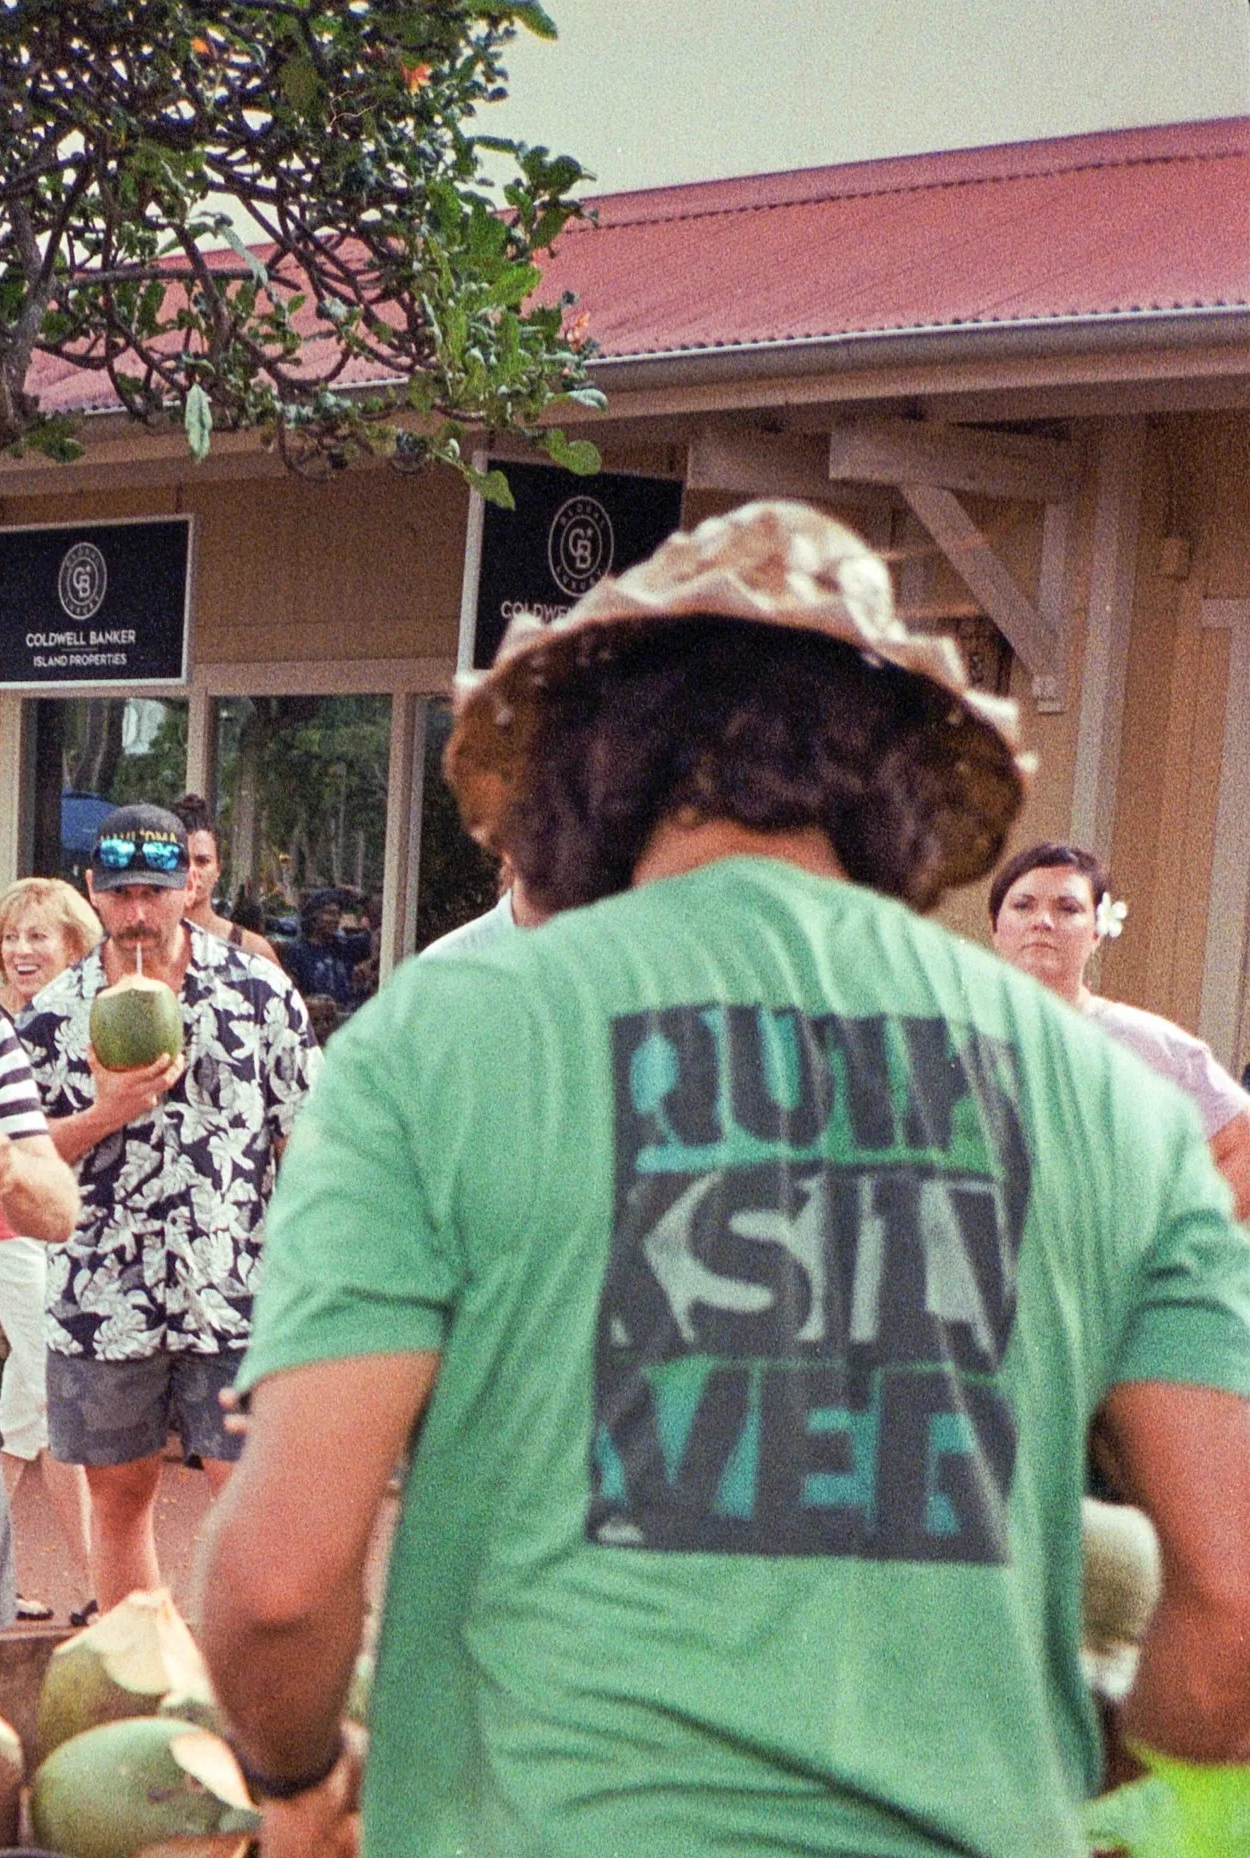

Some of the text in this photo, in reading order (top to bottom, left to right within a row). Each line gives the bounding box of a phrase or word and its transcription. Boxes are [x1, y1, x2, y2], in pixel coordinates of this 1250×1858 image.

[500, 600, 573, 624] COLDWE
[25, 629, 136, 648] COLDWELL BANKER
[33, 653, 128, 667] ISLAND PROPERTIES
